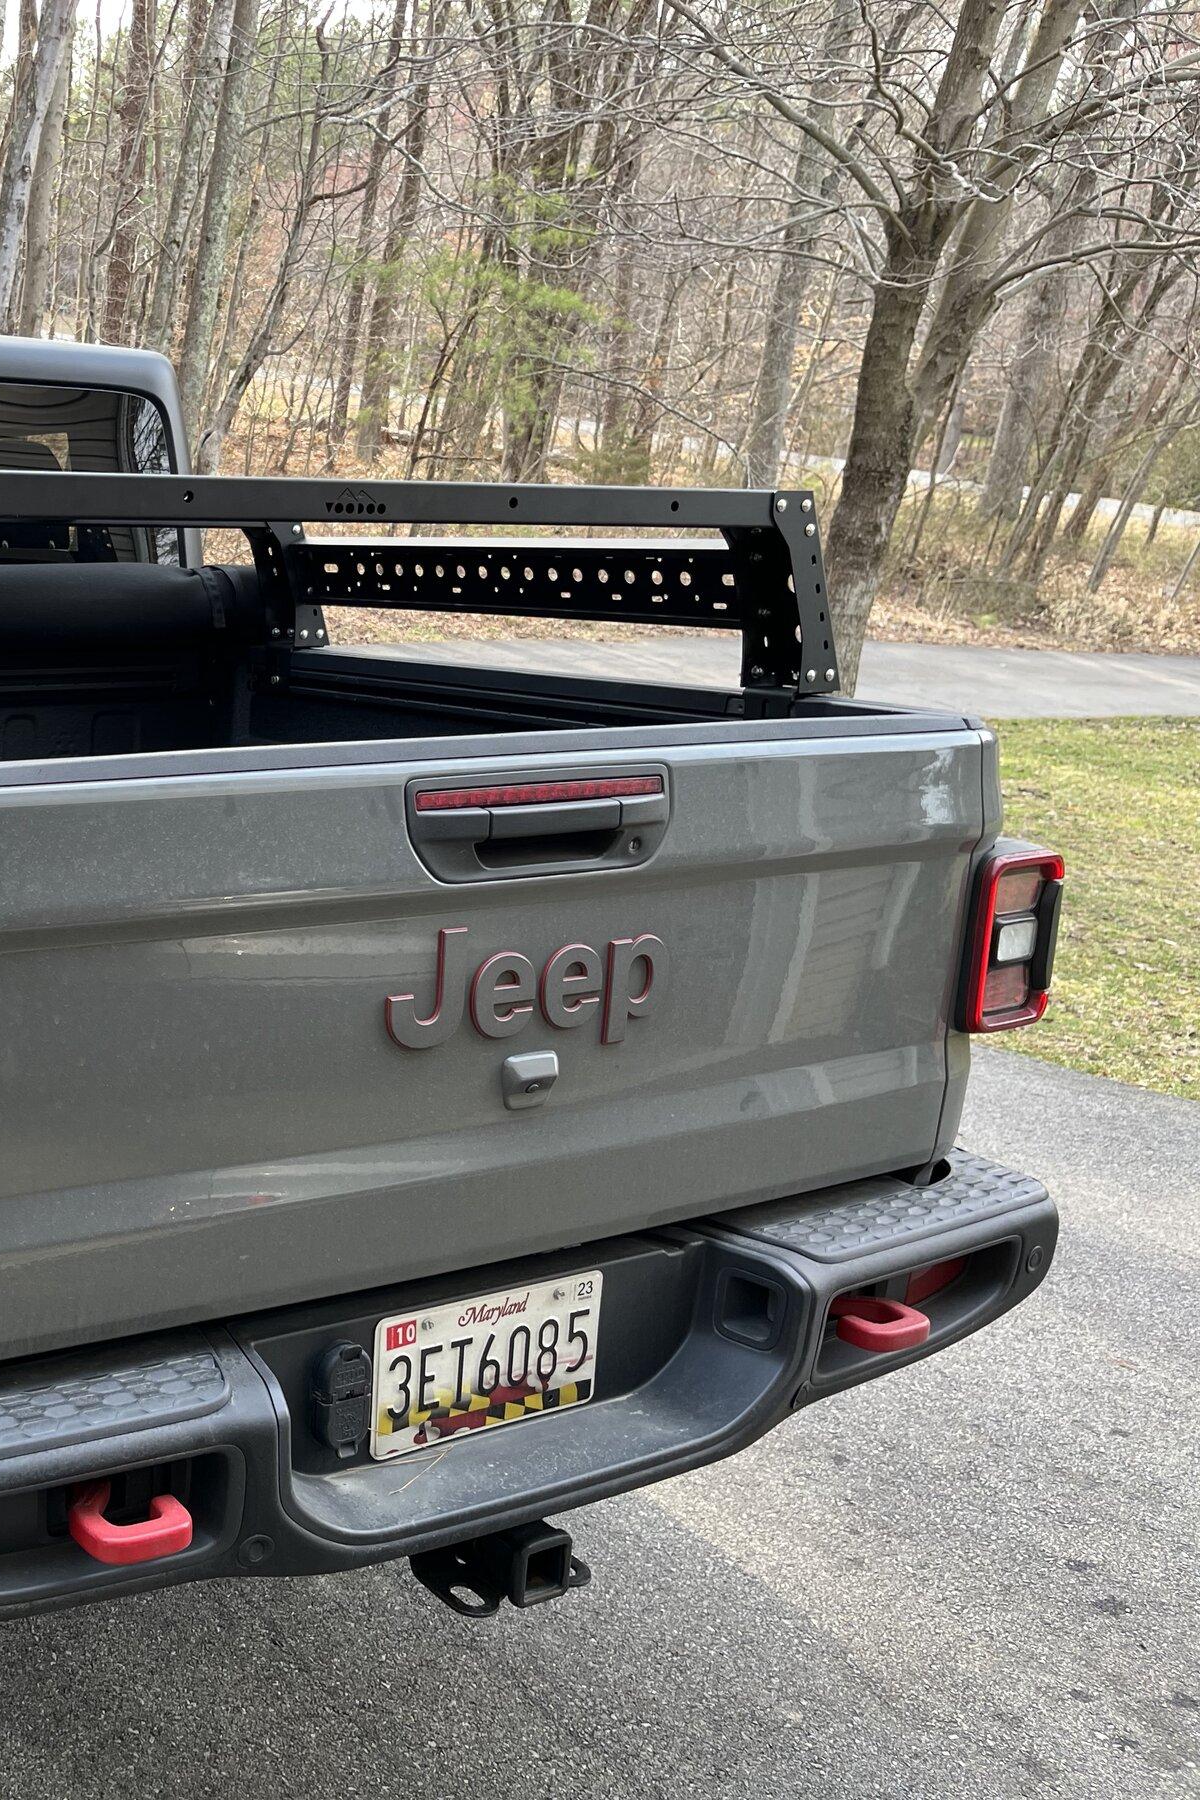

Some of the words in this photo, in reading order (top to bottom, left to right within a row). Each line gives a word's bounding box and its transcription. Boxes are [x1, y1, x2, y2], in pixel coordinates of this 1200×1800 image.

[325, 502, 387, 515] VOODOO
[384, 926, 668, 1050] Jeep
[577, 1280, 593, 1297] 23
[457, 1292, 530, 1327] Maryland
[396, 1323, 416, 1345] 10
[387, 1308, 591, 1420] 3ET6085
